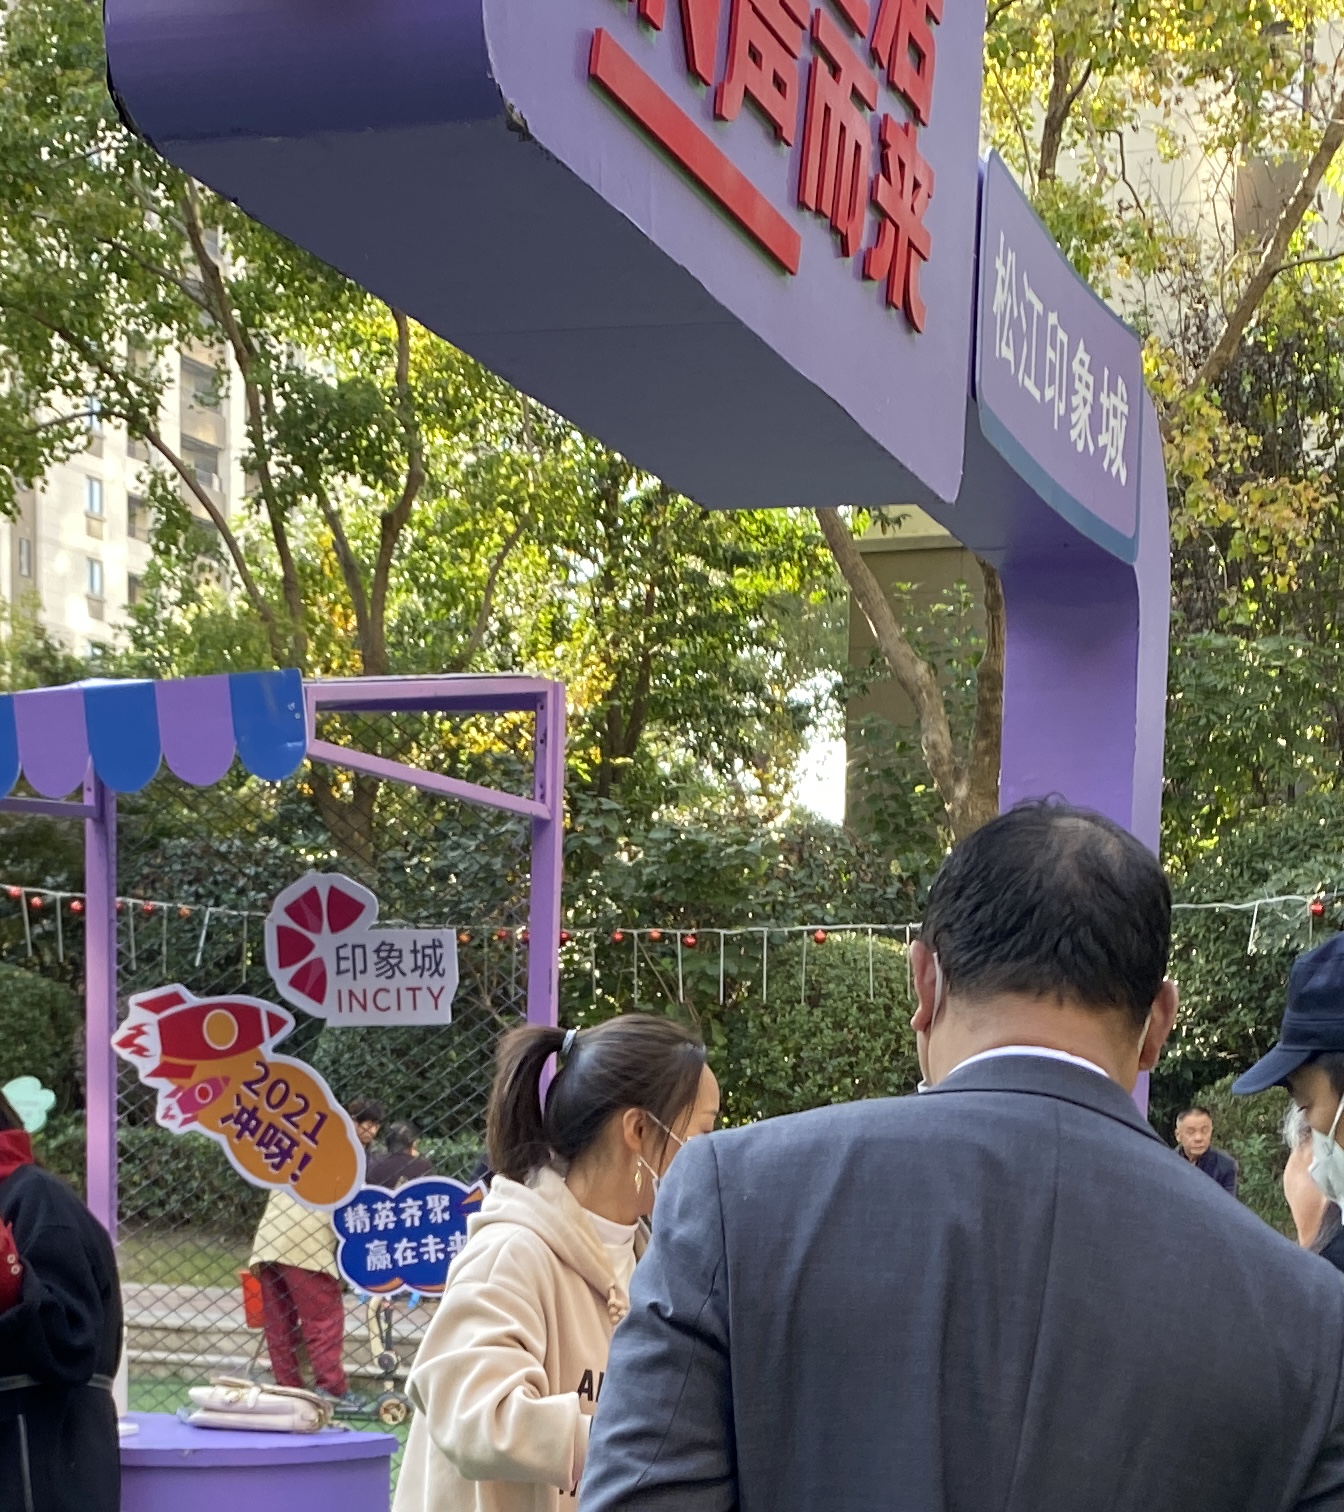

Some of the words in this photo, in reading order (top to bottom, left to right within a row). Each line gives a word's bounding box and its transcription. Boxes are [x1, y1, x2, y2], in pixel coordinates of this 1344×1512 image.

[992, 230, 1131, 487] 松江印象城
[334, 938, 447, 981] 印象城
[336, 986, 446, 1014] INCITY
[241, 1060, 331, 1147] 2021
[342, 1194, 451, 1234] 精英齐聚
[365, 1230, 468, 1273] 赢在未来
